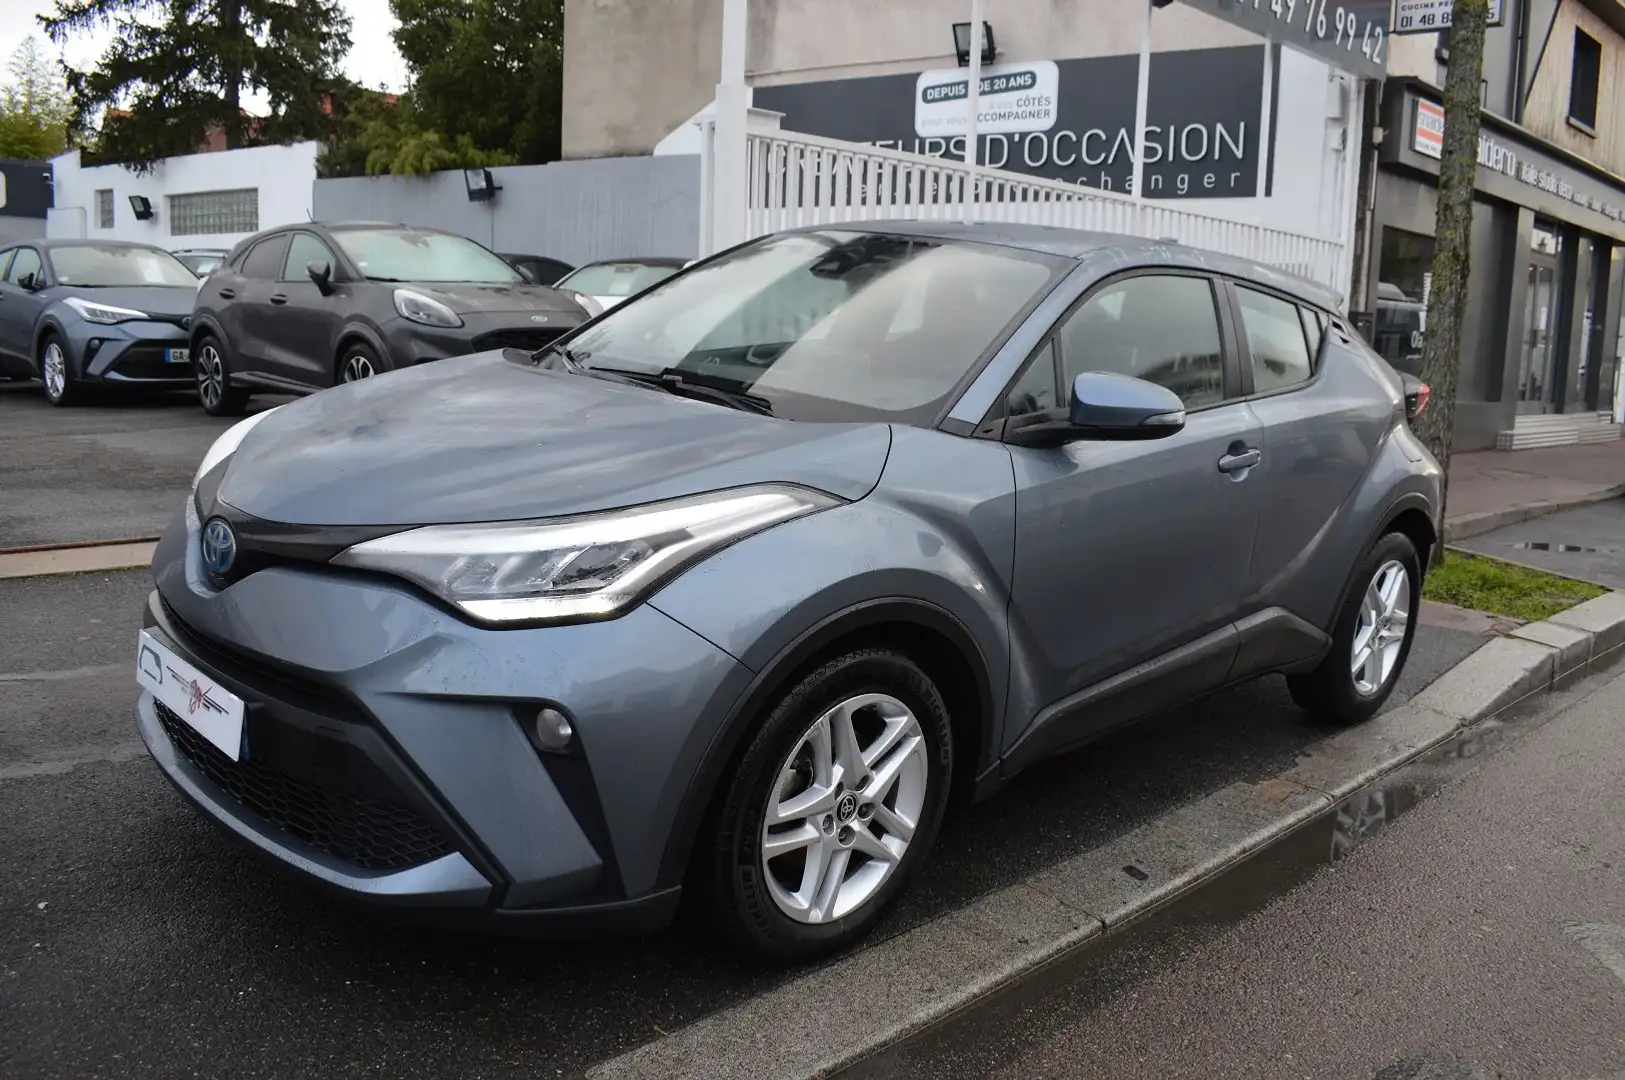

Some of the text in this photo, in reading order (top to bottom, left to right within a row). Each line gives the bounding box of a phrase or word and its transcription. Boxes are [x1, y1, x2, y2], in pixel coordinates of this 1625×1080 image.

[1306, 0, 1327, 38] 76
[1335, 6, 1356, 51] 99
[1362, 21, 1383, 64] 42
[1400, 15, 1413, 28] 01
[1419, 13, 1435, 26] 48
[926, 84, 966, 100] DEPUIS
[993, 77, 1006, 90] 20
[1008, 73, 1032, 87] ANS
[977, 108, 1051, 123] CCOMPAGNER
[985, 121, 1246, 168] D'OCCASION
